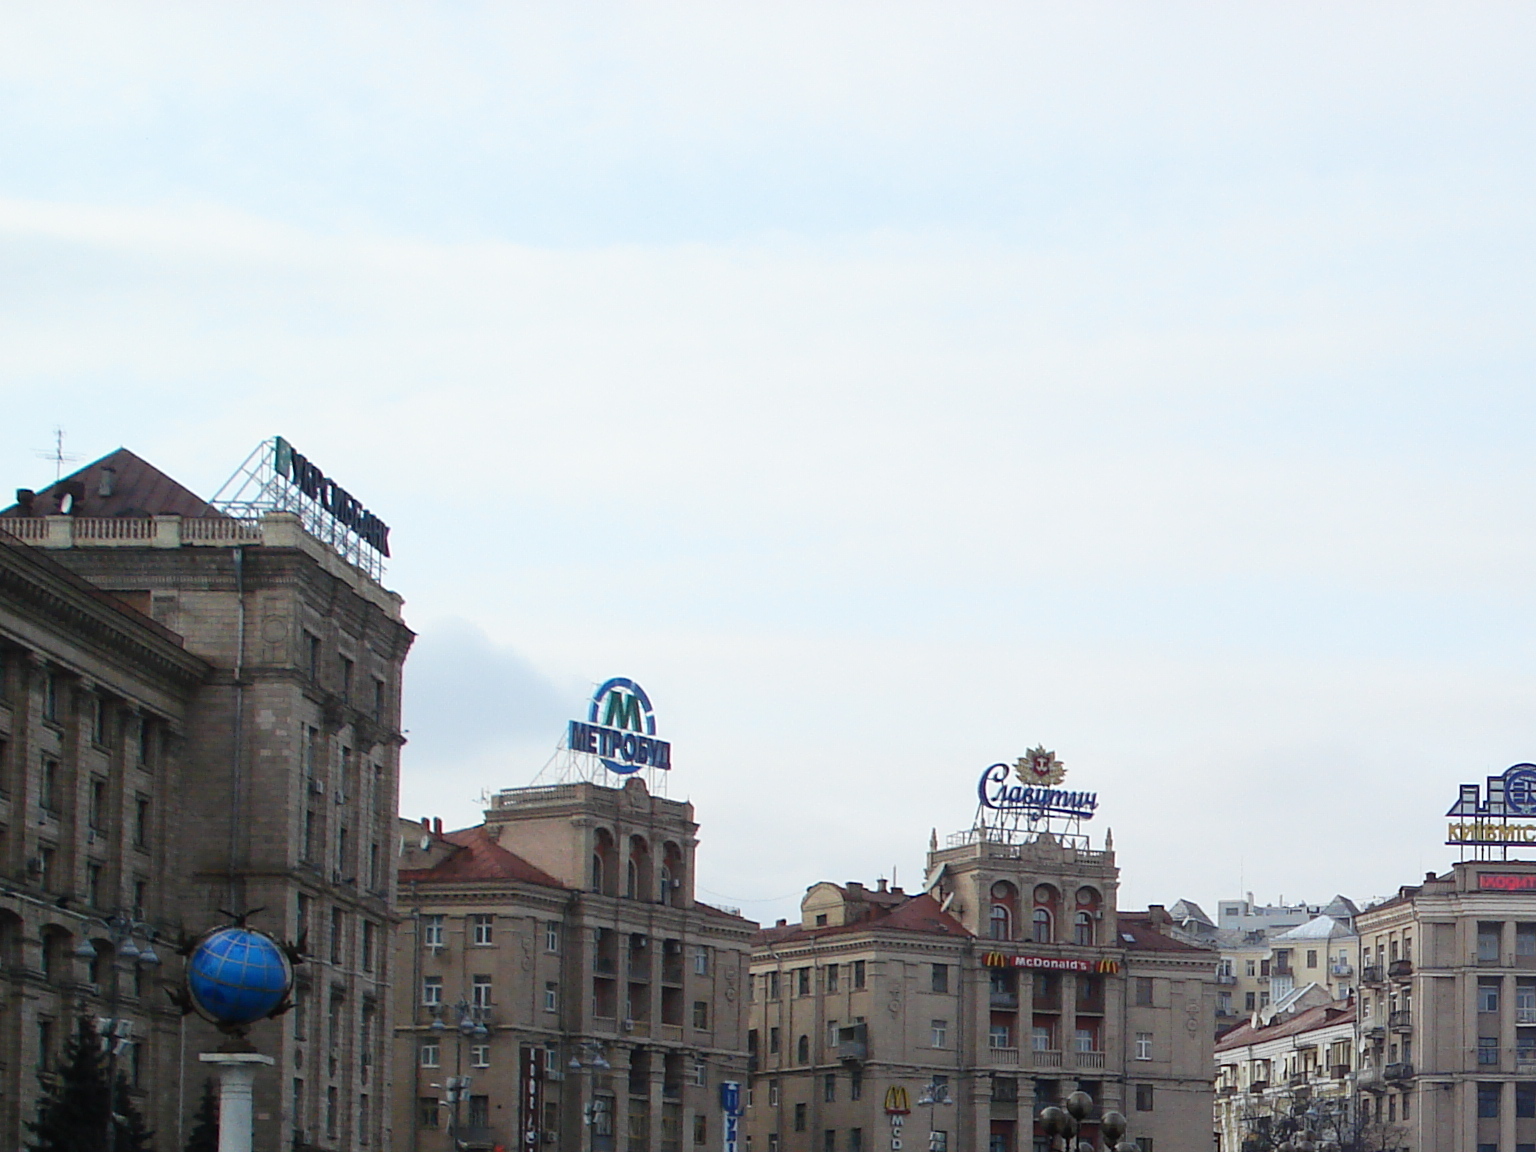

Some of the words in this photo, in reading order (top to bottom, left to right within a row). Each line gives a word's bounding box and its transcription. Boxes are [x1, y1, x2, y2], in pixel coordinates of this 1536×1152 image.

[568, 720, 671, 770] МЕТРОБУД
[978, 763, 1099, 821] Славутич
[1015, 957, 1087, 970] McDonald's
